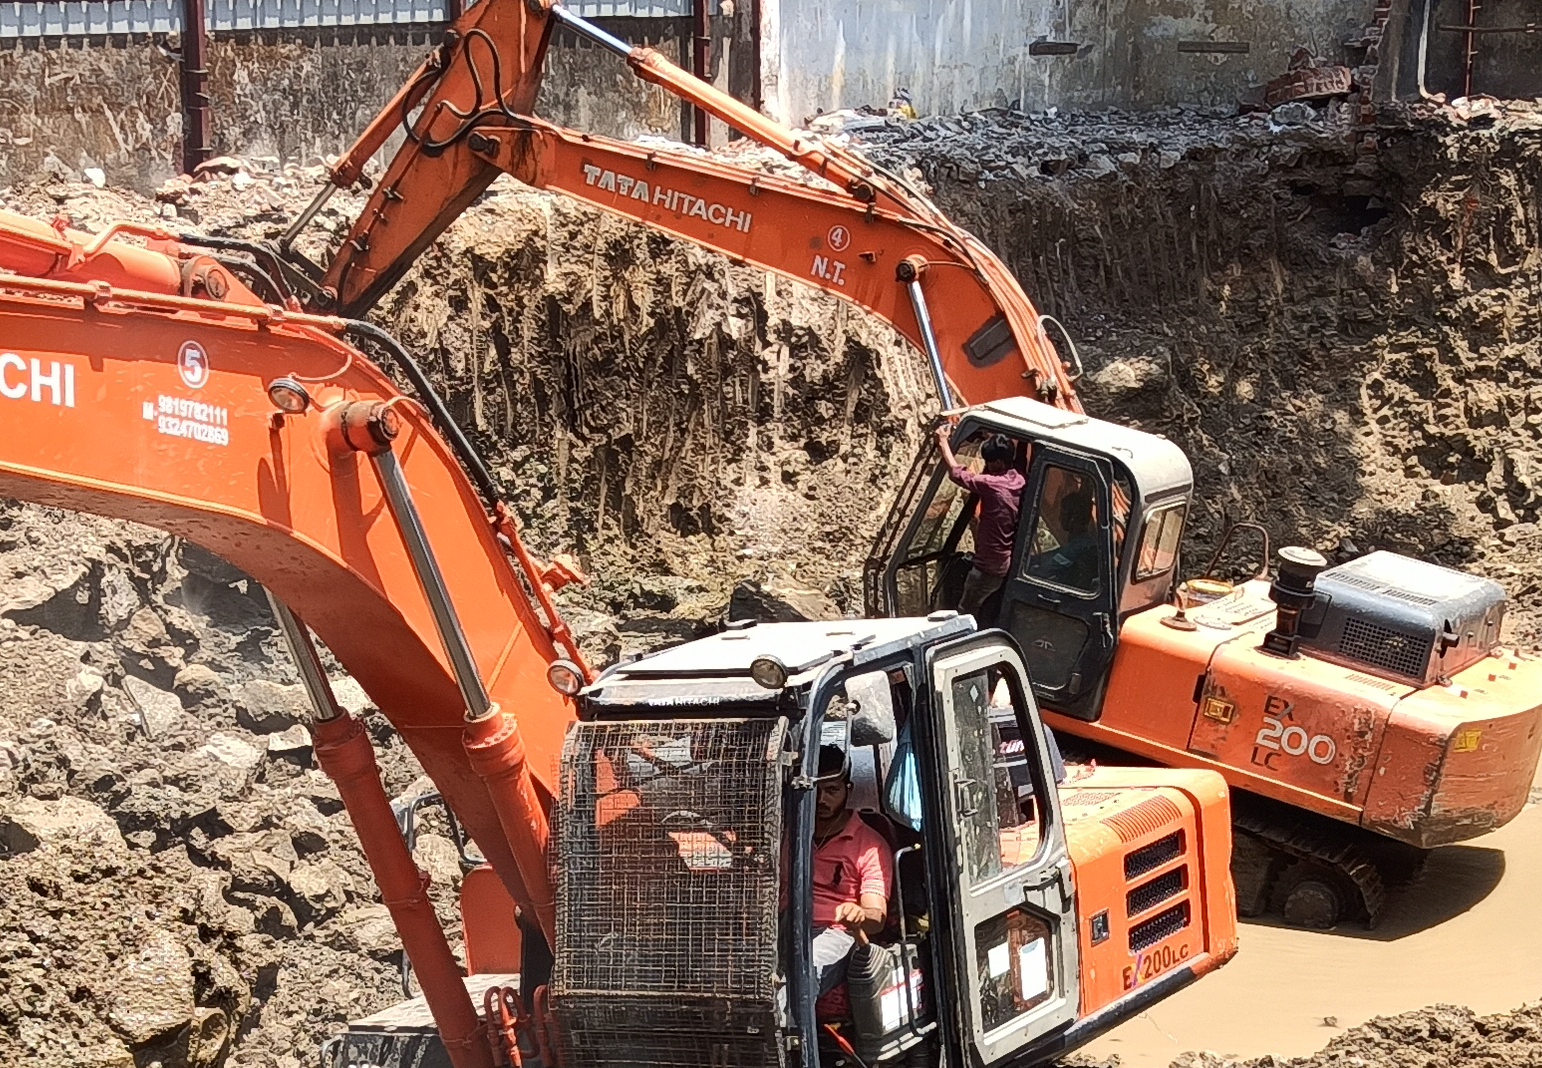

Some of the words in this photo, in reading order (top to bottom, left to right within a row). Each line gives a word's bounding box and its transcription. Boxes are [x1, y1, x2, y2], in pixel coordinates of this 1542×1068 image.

[583, 164, 649, 202] TATA
[653, 186, 752, 233] HITACHI
[811, 254, 846, 286] N.T.
[1263, 695, 1295, 721] EX
[1256, 716, 1336, 765] 200
[1251, 746, 1281, 772] LC
